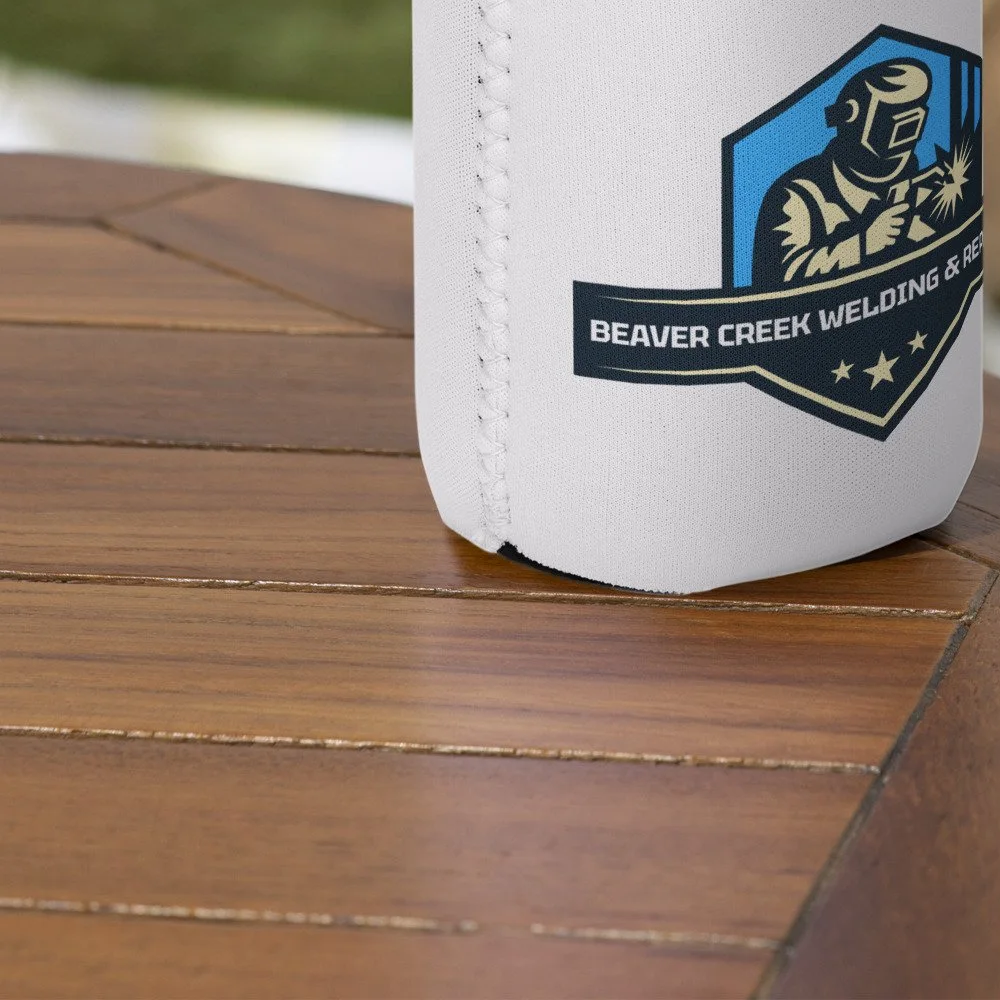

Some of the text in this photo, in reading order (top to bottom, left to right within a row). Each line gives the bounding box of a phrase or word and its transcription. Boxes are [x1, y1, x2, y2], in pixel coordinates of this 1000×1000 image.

[590, 319, 710, 349] BEAVER
[718, 312, 812, 347] CREEK
[818, 266, 939, 331] WELDING
[944, 254, 960, 281] &
